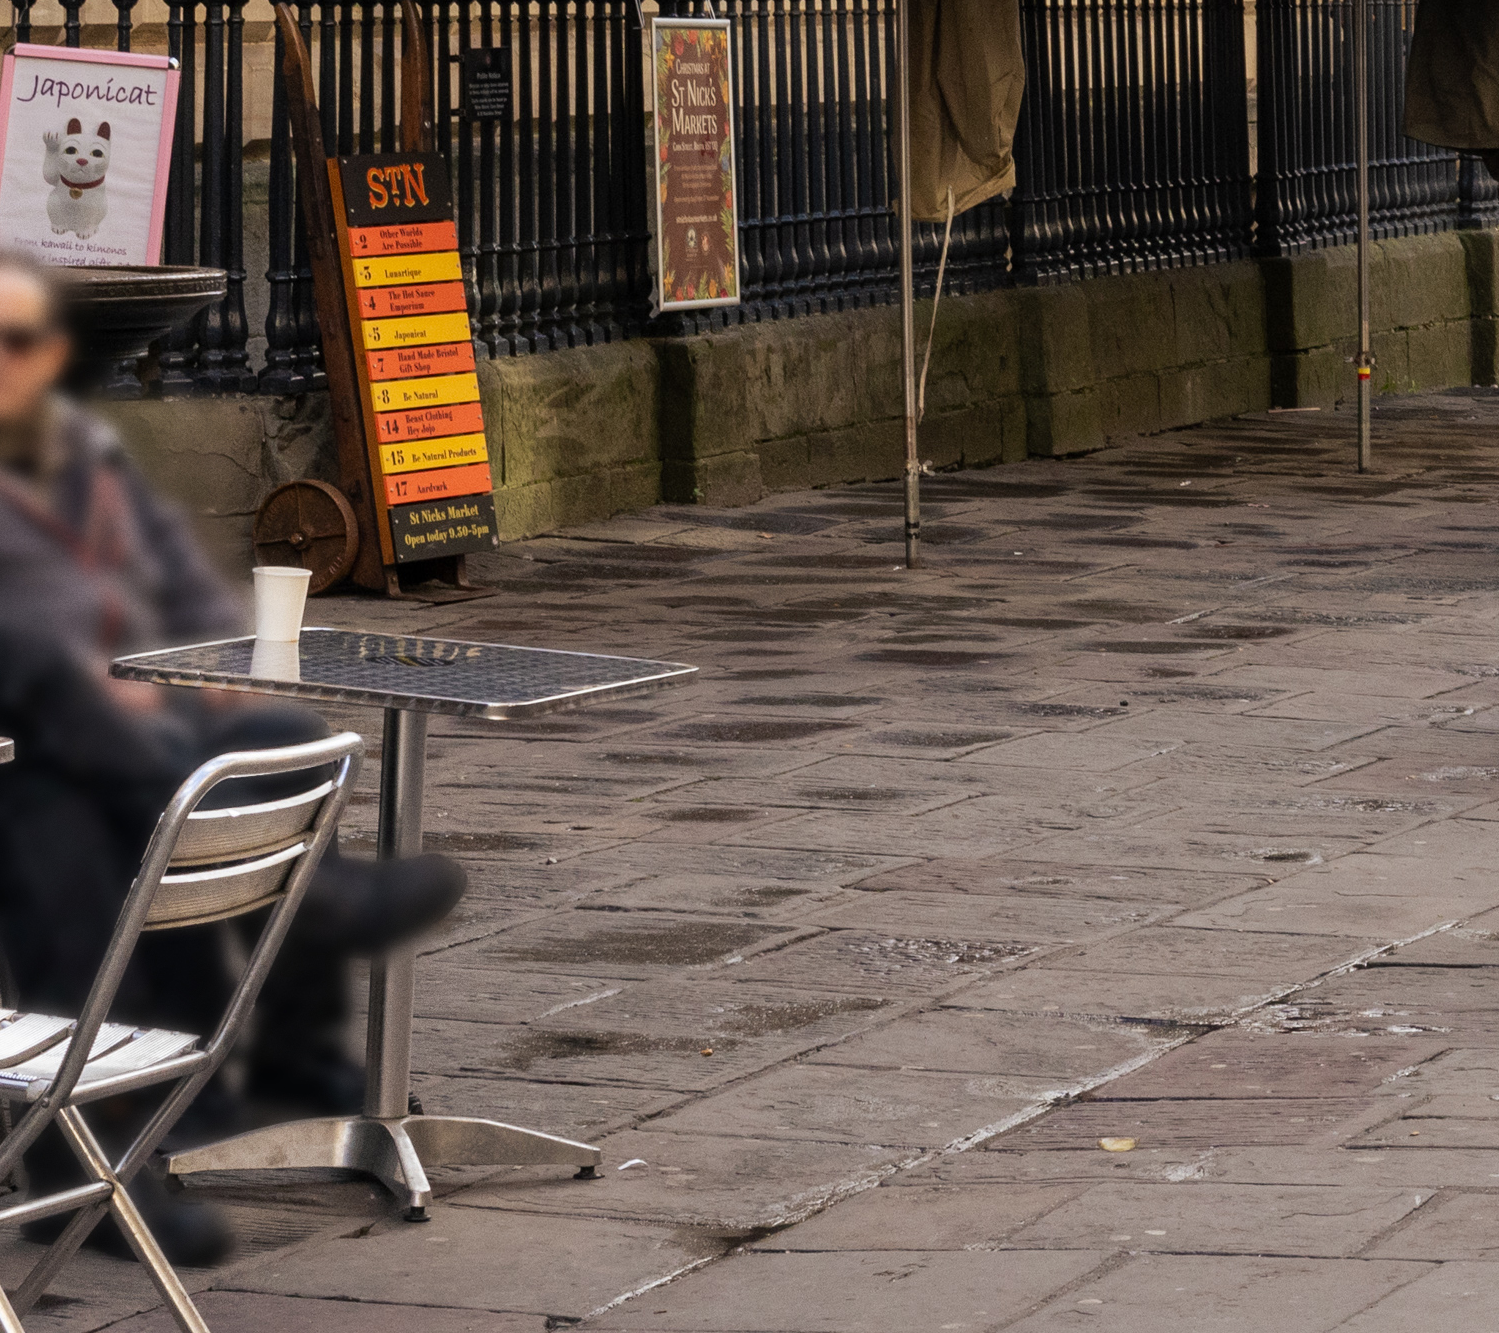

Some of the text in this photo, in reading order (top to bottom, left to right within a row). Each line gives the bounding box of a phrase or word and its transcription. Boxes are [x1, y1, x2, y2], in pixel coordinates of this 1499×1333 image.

[676, 59, 711, 75] CHRISTMAS AT
[16, 74, 158, 109] Japonicat
[671, 77, 717, 107] ST NICK'S
[672, 107, 718, 136] MARKETS
[379, 227, 423, 239] Other Worlds
[40, 237, 72, 250] kawaii
[75, 242, 85, 251] to
[86, 242, 128, 256] kimonos
[359, 237, 368, 249] 2
[382, 239, 423, 251] Are Possible
[364, 265, 422, 280] 3 Lunartique
[388, 289, 436, 300] The Hot Sauce
[368, 295, 376, 310] 4
[389, 301, 425, 314] Emporium
[372, 327, 427, 342] 5 Japonicat
[397, 349, 459, 362] Hand Made Bristol
[377, 357, 385, 373] 7
[399, 363, 432, 374] Gift Shop
[381, 389, 439, 405] 8 Be Natural
[425, 411, 454, 422] Clothing
[385, 420, 400, 435] 14
[407, 426, 420, 438] Hey
[390, 448, 477, 466] 15 Be Natural Products
[395, 481, 448, 497] 17 Aardvark
[409, 504, 480, 525] St Nicks Market
[404, 533, 426, 549] Open
[426, 531, 448, 546] today
